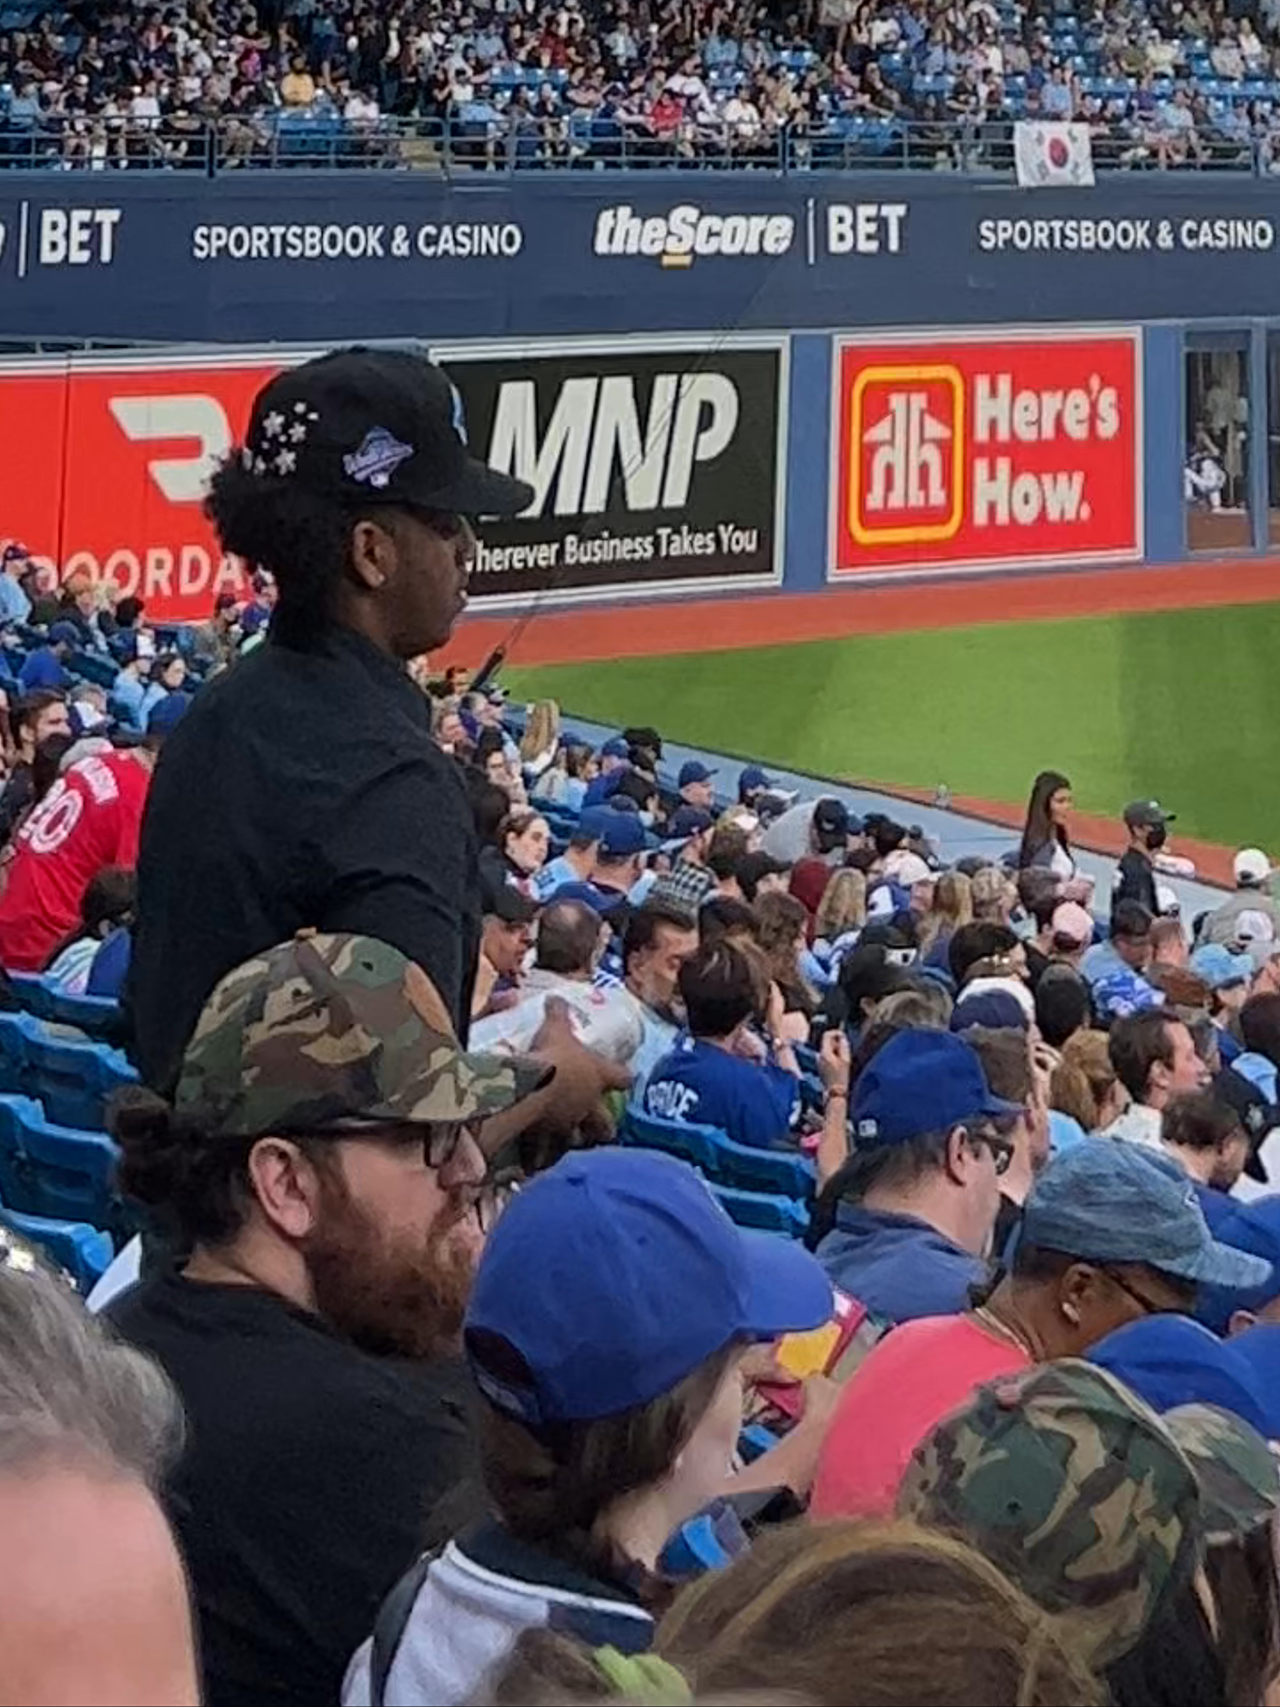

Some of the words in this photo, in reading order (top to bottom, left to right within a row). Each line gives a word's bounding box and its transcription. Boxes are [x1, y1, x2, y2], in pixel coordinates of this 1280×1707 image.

[40, 208, 121, 263] BET
[193, 224, 384, 259] SPORTSBOOK
[390, 225, 411, 257] &
[417, 223, 522, 257] CASINO
[594, 205, 795, 257] theScore
[827, 203, 907, 254] BET
[979, 219, 1150, 251] SPORTSBOOK
[1156, 221, 1174, 249] &
[1181, 219, 1274, 250] CASINO
[973, 373, 1120, 443] Here's
[480, 373, 739, 521] MNP
[973, 456, 1091, 526] How.
[565, 532, 654, 565] Business
[657, 524, 717, 558] Takes
[719, 523, 758, 555] You
